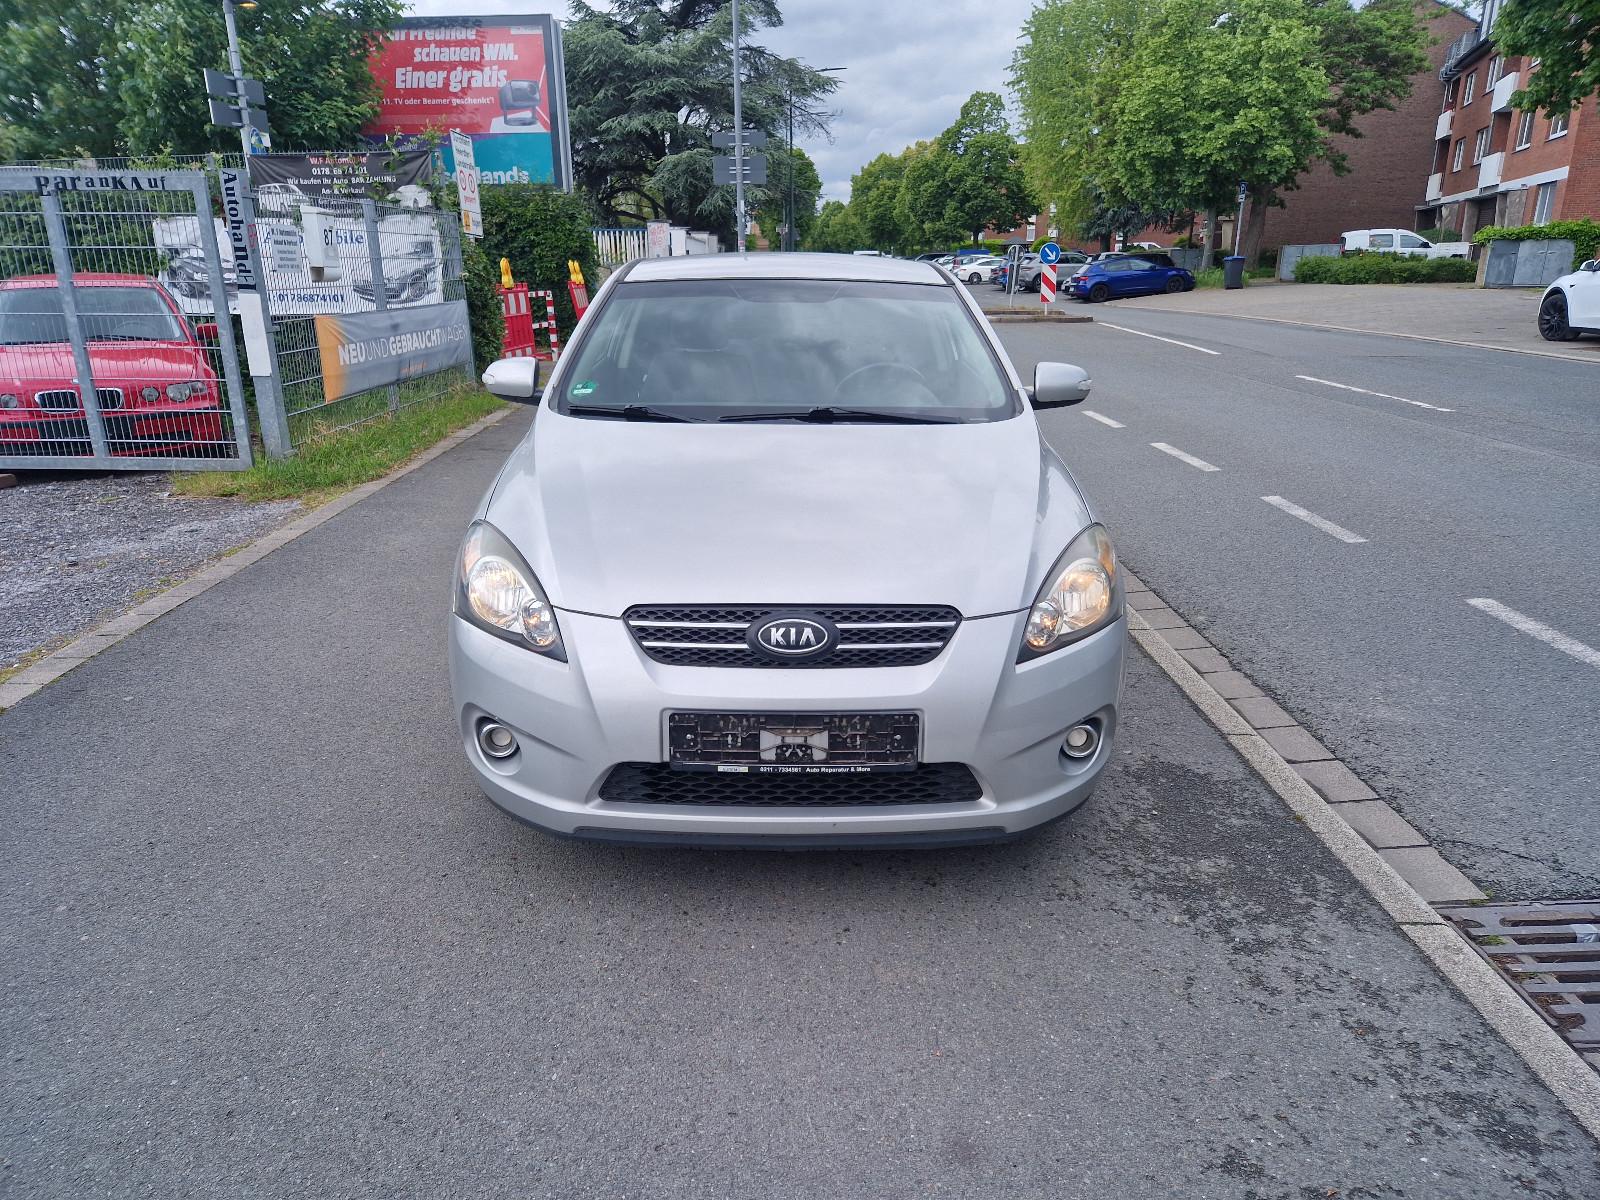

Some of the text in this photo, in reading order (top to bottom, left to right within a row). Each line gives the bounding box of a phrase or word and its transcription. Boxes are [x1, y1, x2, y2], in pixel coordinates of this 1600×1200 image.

[413, 43, 519, 62] schauen WM.
[395, 67, 447, 89] Einer
[404, 97, 421, 105] oder
[422, 97, 450, 105] Beamer
[311, 167, 330, 175] 0178
[300, 177, 321, 185] kaufen
[323, 228, 333, 246] 87
[769, 627, 817, 646] KIA
[820, 766, 849, 774] Reparatur
